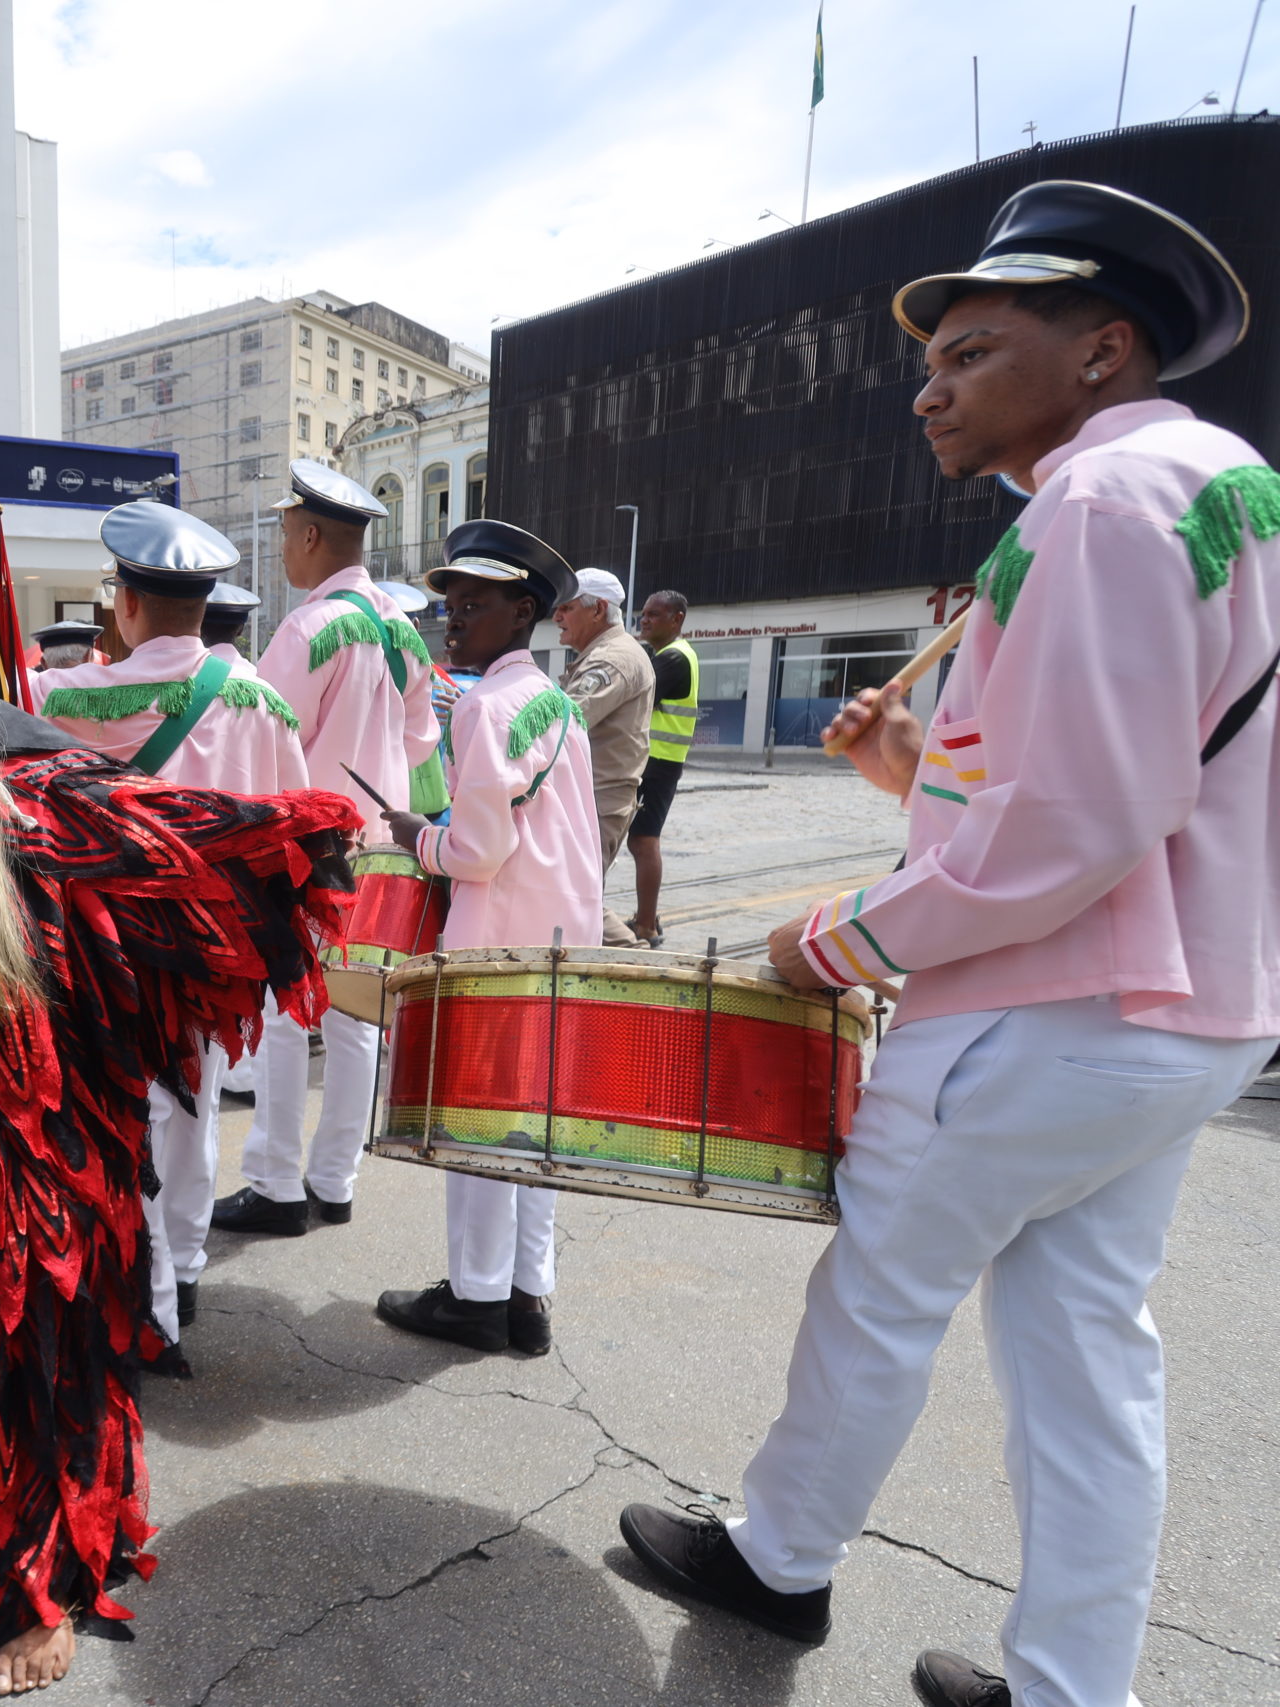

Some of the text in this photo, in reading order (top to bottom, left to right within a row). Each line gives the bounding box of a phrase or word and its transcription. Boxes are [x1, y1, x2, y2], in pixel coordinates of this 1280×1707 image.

[695, 629, 725, 638] Brizola
[727, 626, 762, 637] Alberto
[764, 622, 816, 636] Pasqualini
